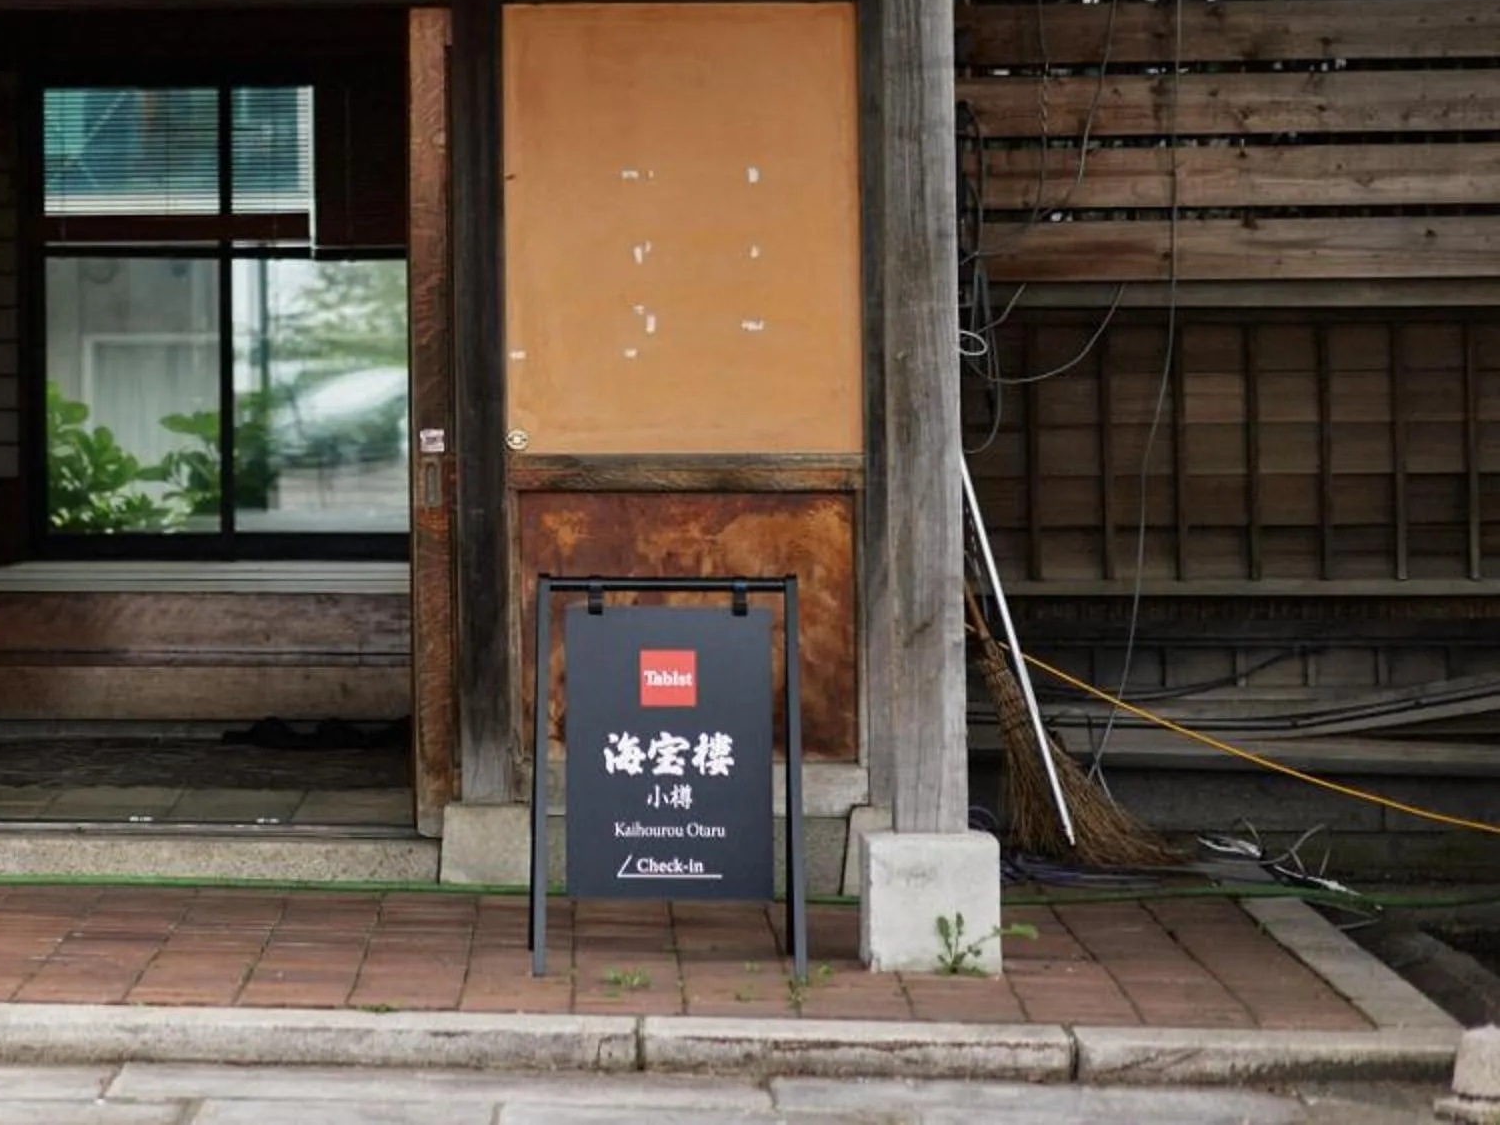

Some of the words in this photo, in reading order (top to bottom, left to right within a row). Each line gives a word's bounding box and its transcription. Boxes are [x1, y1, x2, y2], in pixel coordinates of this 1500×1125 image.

[643, 669, 694, 687] Tabist
[603, 730, 736, 777] 海宝樓
[646, 783, 693, 810] 小樽
[614, 821, 684, 838] Kaihourou
[686, 822, 726, 838] Otaru
[636, 857, 704, 873] Check-in
